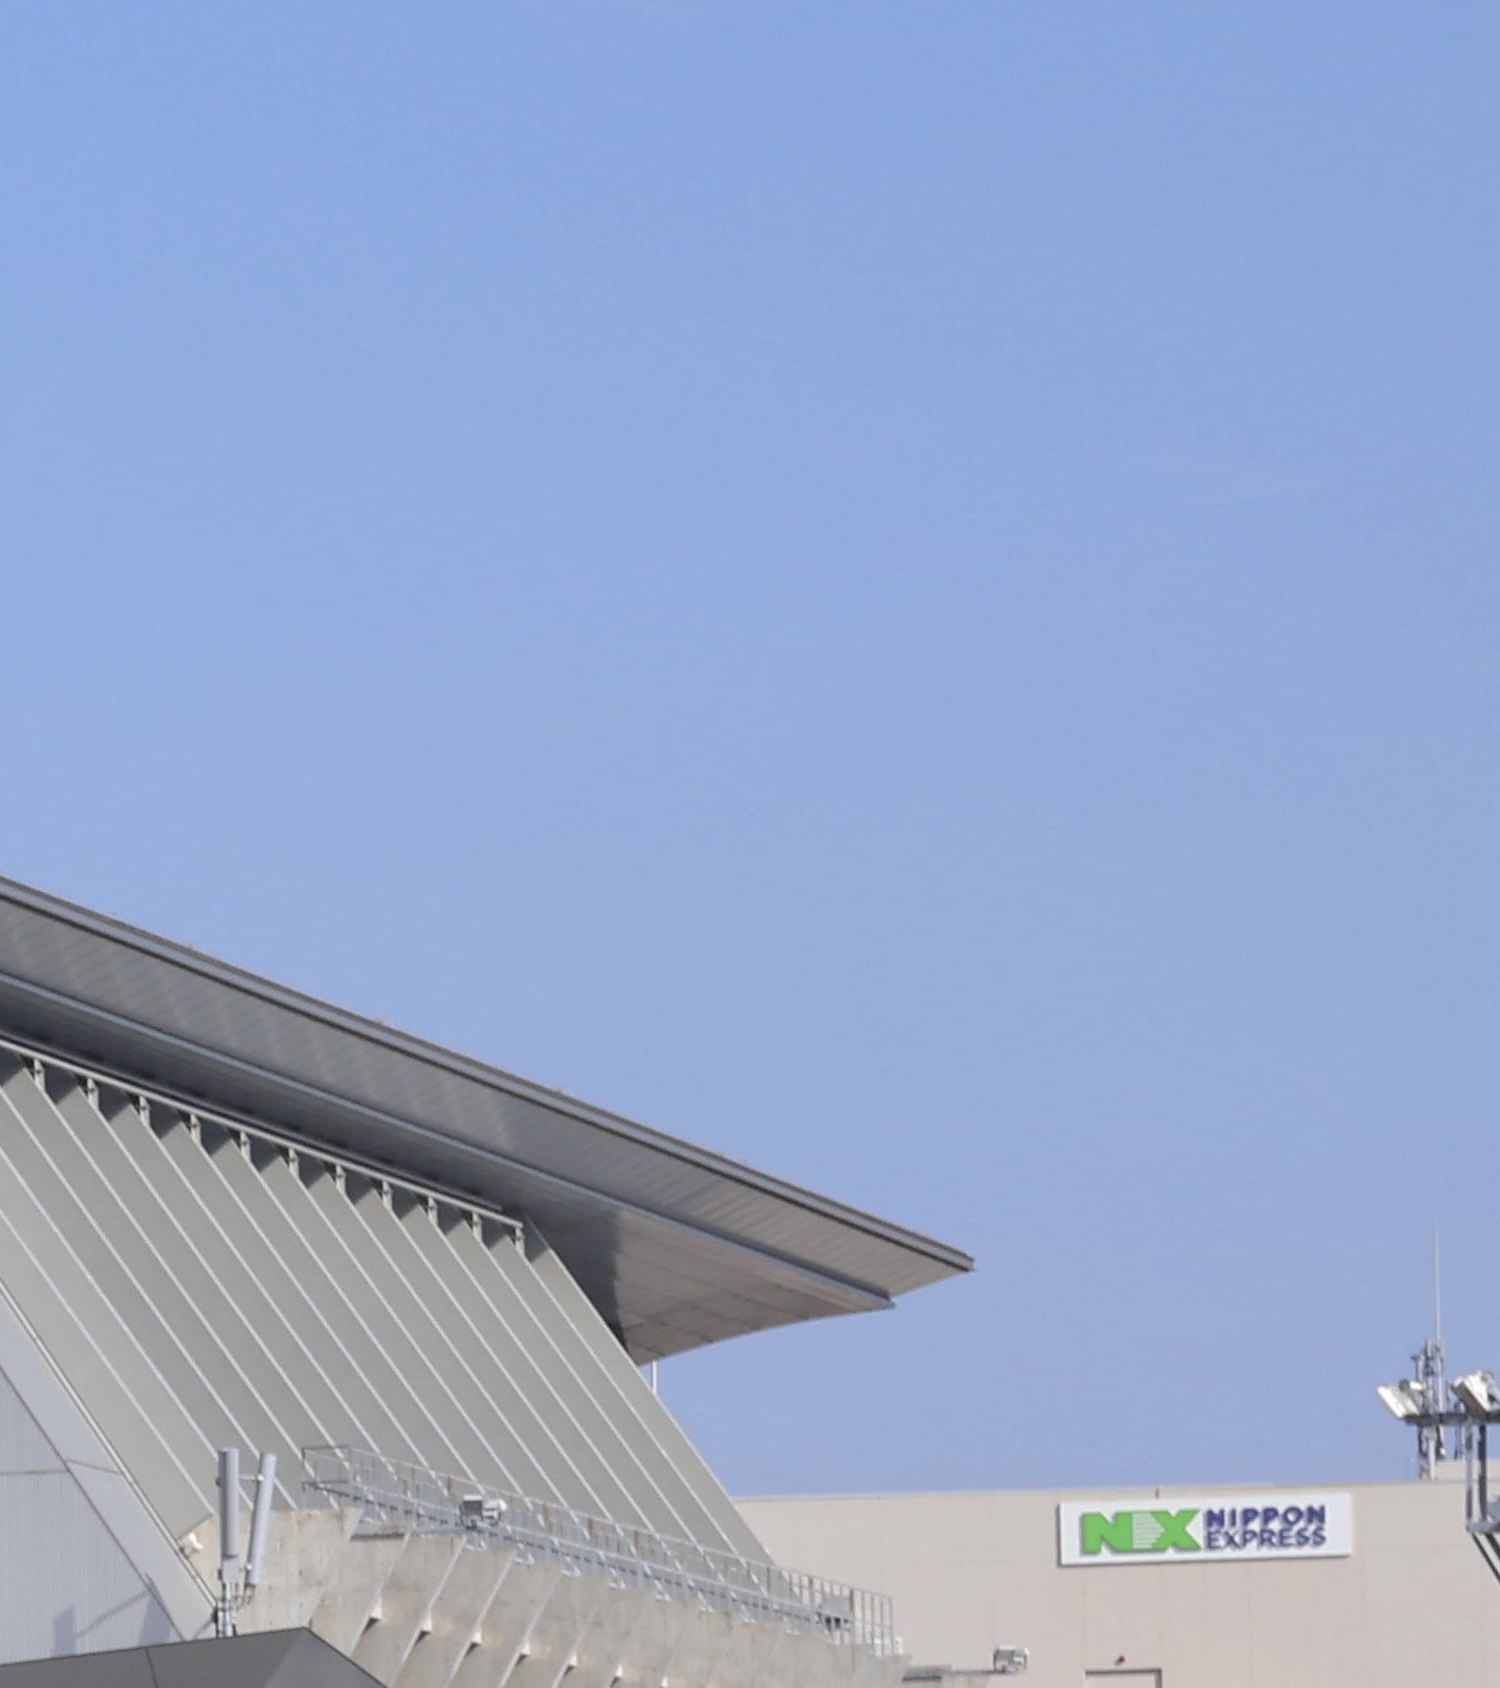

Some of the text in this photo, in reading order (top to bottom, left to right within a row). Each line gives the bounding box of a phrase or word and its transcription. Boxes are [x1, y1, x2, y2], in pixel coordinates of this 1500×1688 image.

[1203, 1505, 1327, 1529] NIPPON
[1080, 1509, 1202, 1555] NX
[1204, 1526, 1327, 1551] EXPRESS
